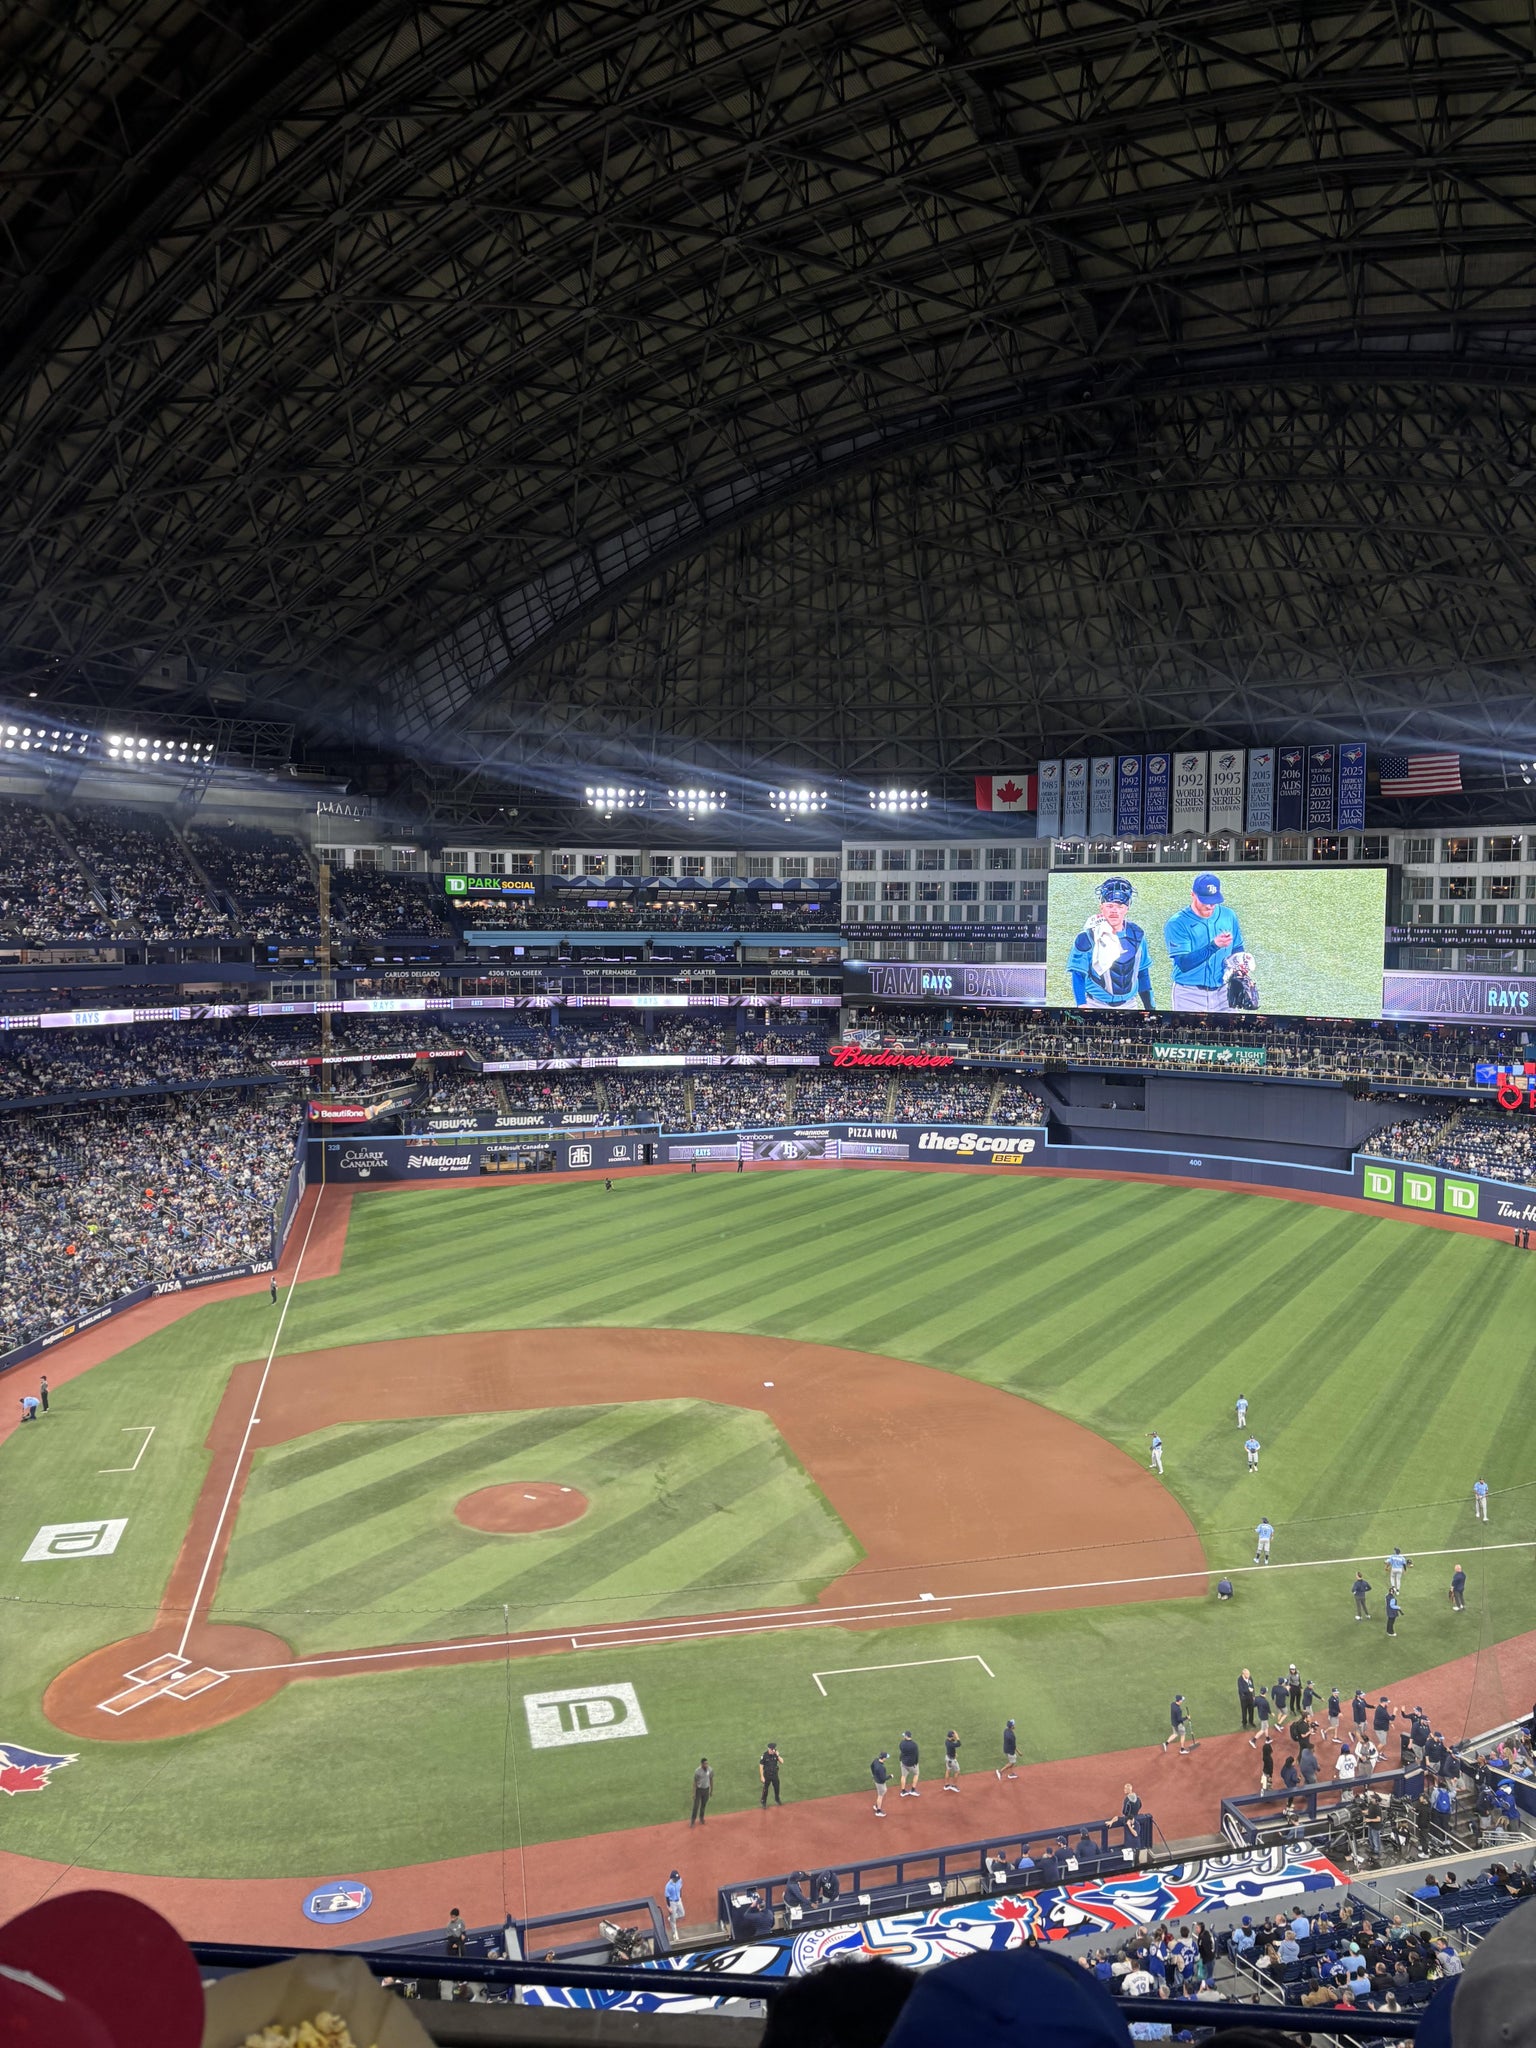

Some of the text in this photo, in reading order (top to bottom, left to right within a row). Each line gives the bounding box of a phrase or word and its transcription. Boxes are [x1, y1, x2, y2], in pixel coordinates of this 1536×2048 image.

[1252, 771, 1270, 780] 2015
[1281, 770, 1300, 779] 2016
[1342, 767, 1363, 776] 2025
[1095, 779, 1110, 787] 1991
[1122, 777, 1138, 786] 1992
[1149, 776, 1166, 784] 1993
[1178, 774, 1203, 786] 1992
[1214, 772, 1240, 785] 1993
[1311, 774, 1330, 783] 2016
[1042, 780, 1058, 790] 1985
[1068, 780, 1084, 789] 1989
[1281, 780, 1301, 789] ALDS
[1176, 789, 1204, 797] WORLD
[1213, 787, 1241, 796] WORLD
[1310, 788, 1331, 796] 2020
[1175, 798, 1203, 806] SERIES
[1212, 796, 1240, 805] SERIES
[1310, 801, 1330, 809] 2022
[1310, 814, 1330, 823] 2023
[1341, 809, 1362, 818] ALCS
[1120, 816, 1138, 824] ALCS
[1147, 815, 1166, 824] ALCS
[447, 878, 535, 891] TD PARK SOCIAL
[922, 975, 952, 990] RAYS
[963, 968, 1013, 996] BAY
[1488, 990, 1530, 1008] RAYS
[373, 1001, 395, 1009] RAYS
[75, 1013, 99, 1024] RAYS
[829, 1046, 954, 1067] Budweiser
[1154, 1047, 1216, 1063] WESTJET
[428, 1118, 478, 1130] SUBWAY
[495, 1116, 544, 1126] SUBWAY
[848, 1127, 897, 1140] PIZZA NOVA
[918, 1132, 1035, 1153] theScore
[345, 1150, 384, 1160] CLEARLY
[780, 1141, 798, 1159] TB
[866, 1146, 882, 1154] RAYS
[340, 1159, 388, 1168] CANADIAN
[422, 1154, 471, 1166] National
[1367, 1172, 1392, 1194] TD
[1406, 1180, 1432, 1202] TD
[1448, 1186, 1475, 1209] TD
[1497, 1200, 1520, 1220] Tim
[250, 1261, 273, 1274] VISA
[185, 1276, 213, 1286] everywhere
[156, 1280, 181, 1294] VISA
[537, 1696, 628, 1732] TD
